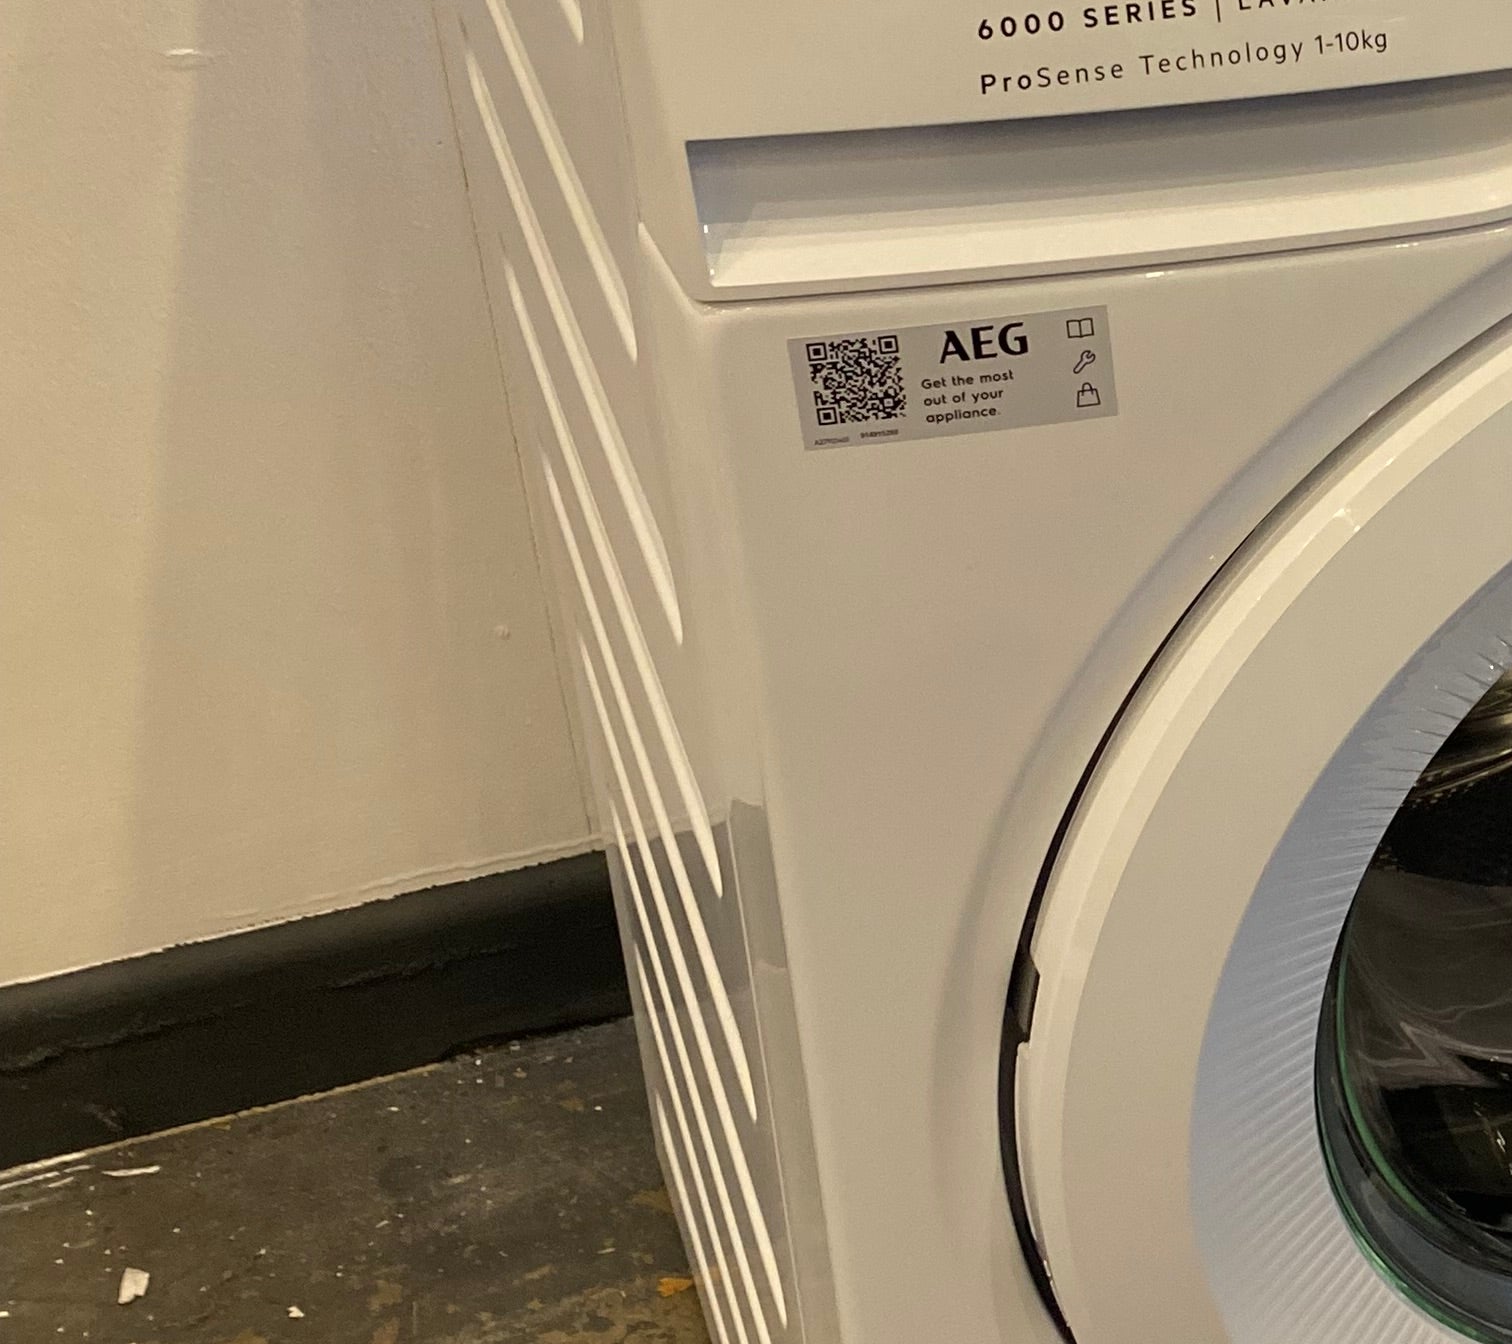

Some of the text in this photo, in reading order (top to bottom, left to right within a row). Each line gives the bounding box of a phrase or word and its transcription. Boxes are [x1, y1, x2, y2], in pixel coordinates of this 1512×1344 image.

[979, 11, 1065, 40] 6000
[981, 30, 1386, 94] ProSense Technology 1-10kg
[940, 322, 1028, 363] AEG
[921, 370, 1013, 389] Get the most
[924, 390, 1003, 406] out of your
[926, 408, 1001, 424] appliance.
